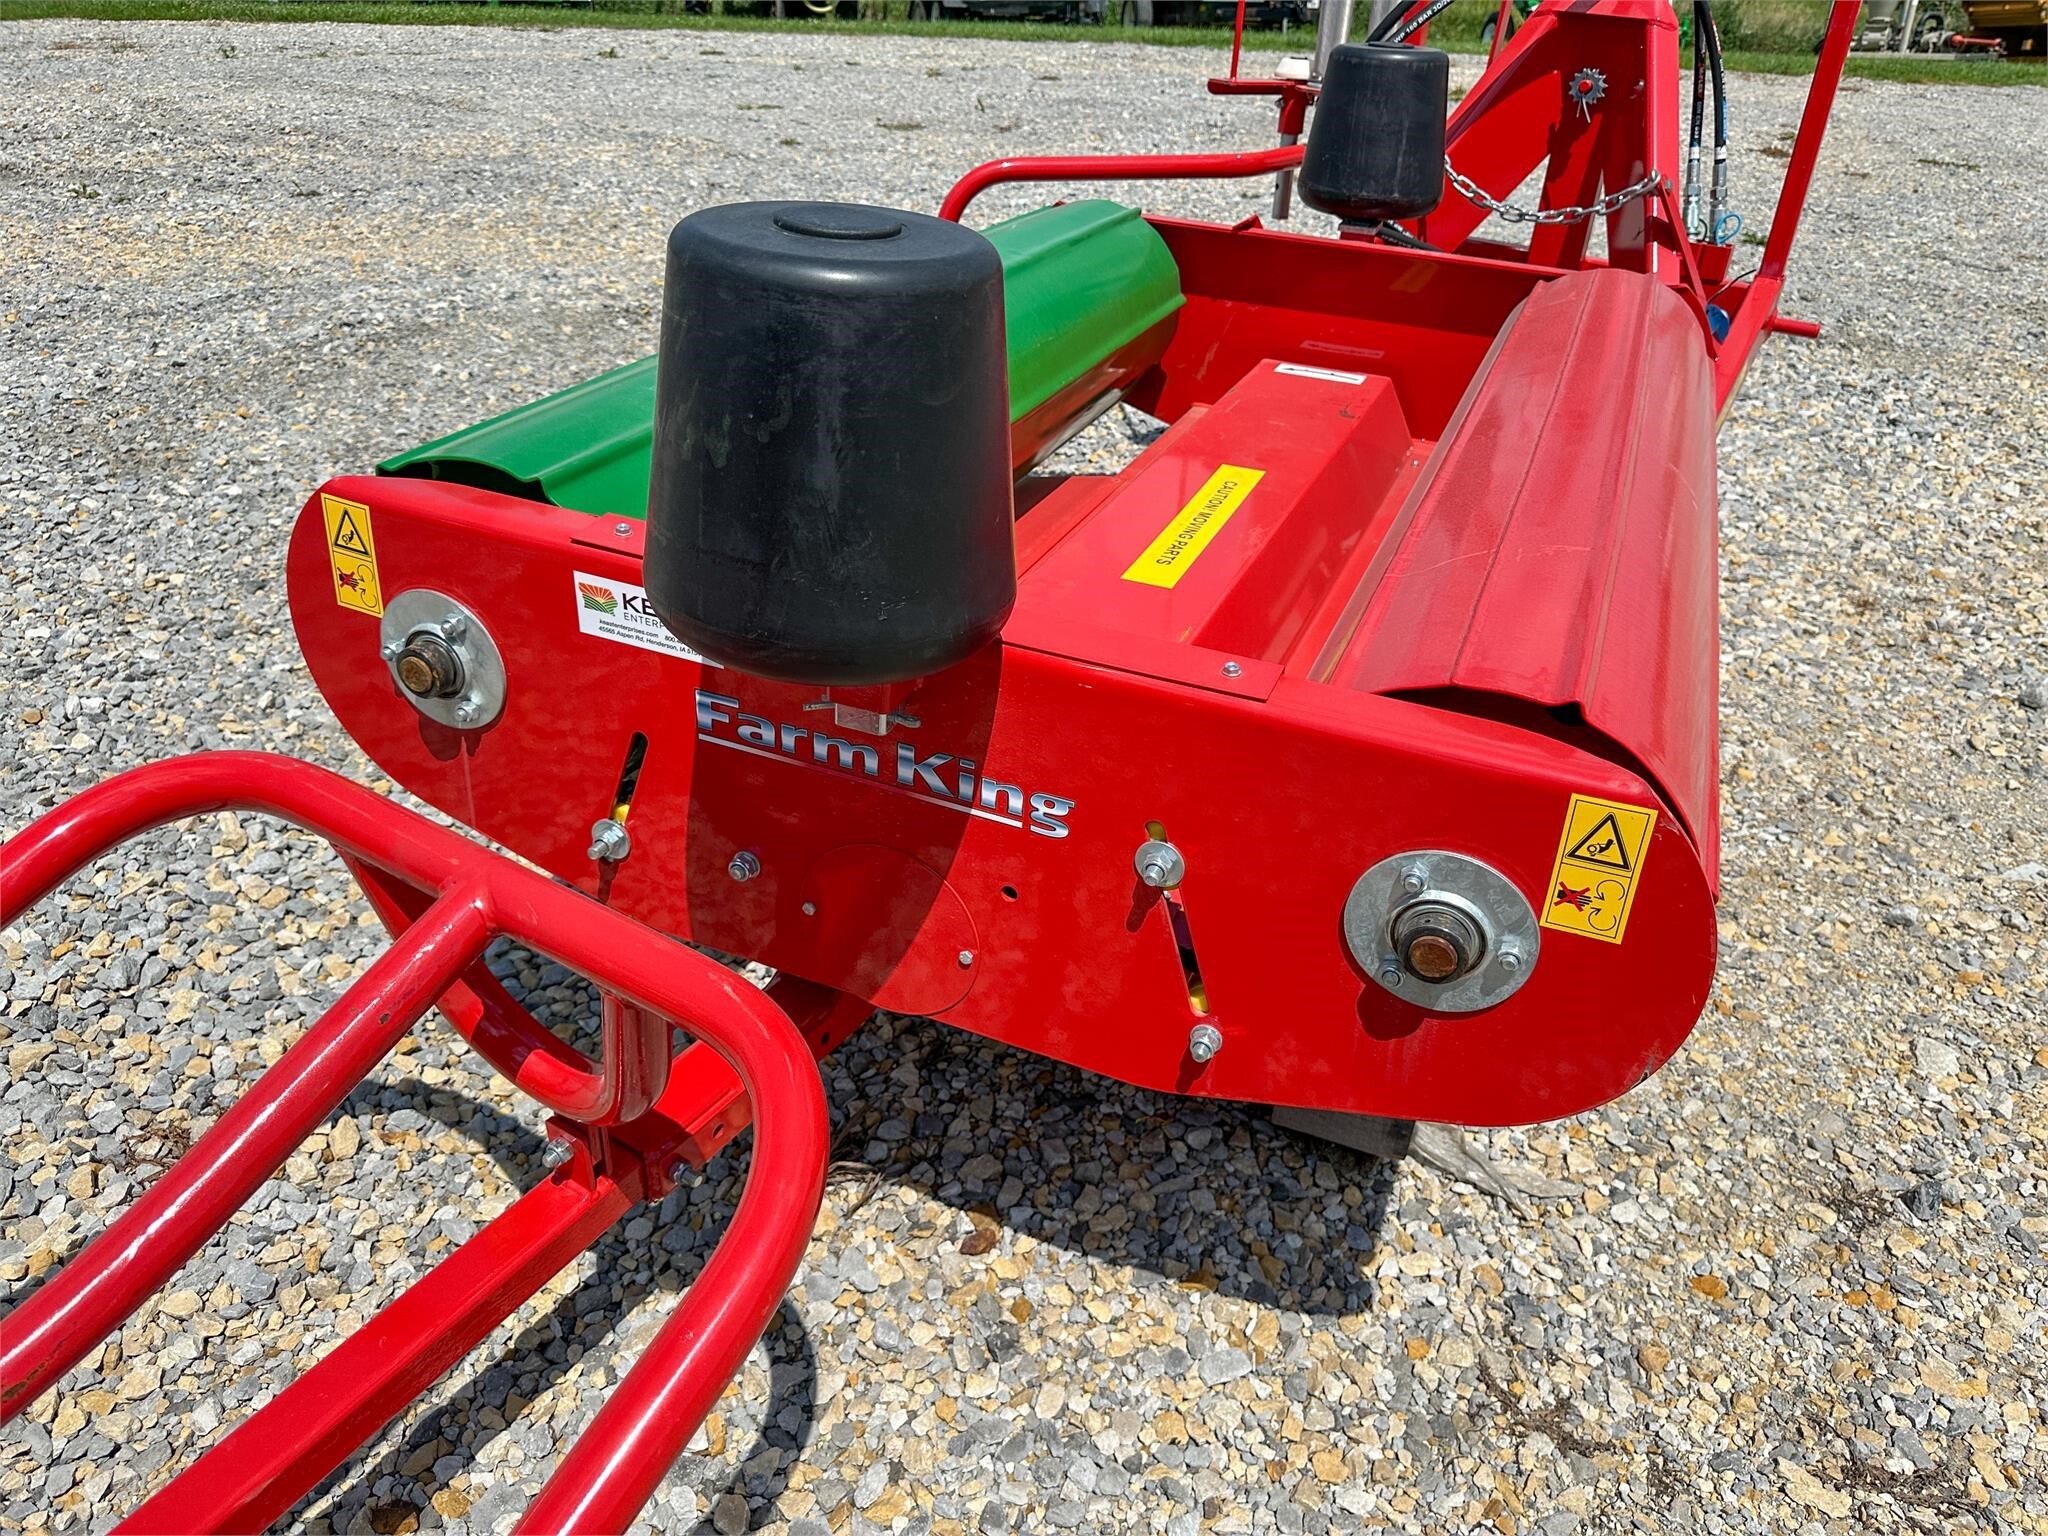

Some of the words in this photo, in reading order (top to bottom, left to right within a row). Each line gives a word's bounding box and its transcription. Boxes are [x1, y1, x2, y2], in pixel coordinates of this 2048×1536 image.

[1202, 480, 1238, 512] CAUTION!
[1178, 512, 1213, 540] MOVING
[1156, 540, 1188, 565] PARTS
[622, 592, 658, 618] KE
[623, 612, 665, 629] ENTERP
[616, 630, 635, 640] Aspen
[694, 688, 880, 777] Farm
[896, 740, 1077, 839] King
